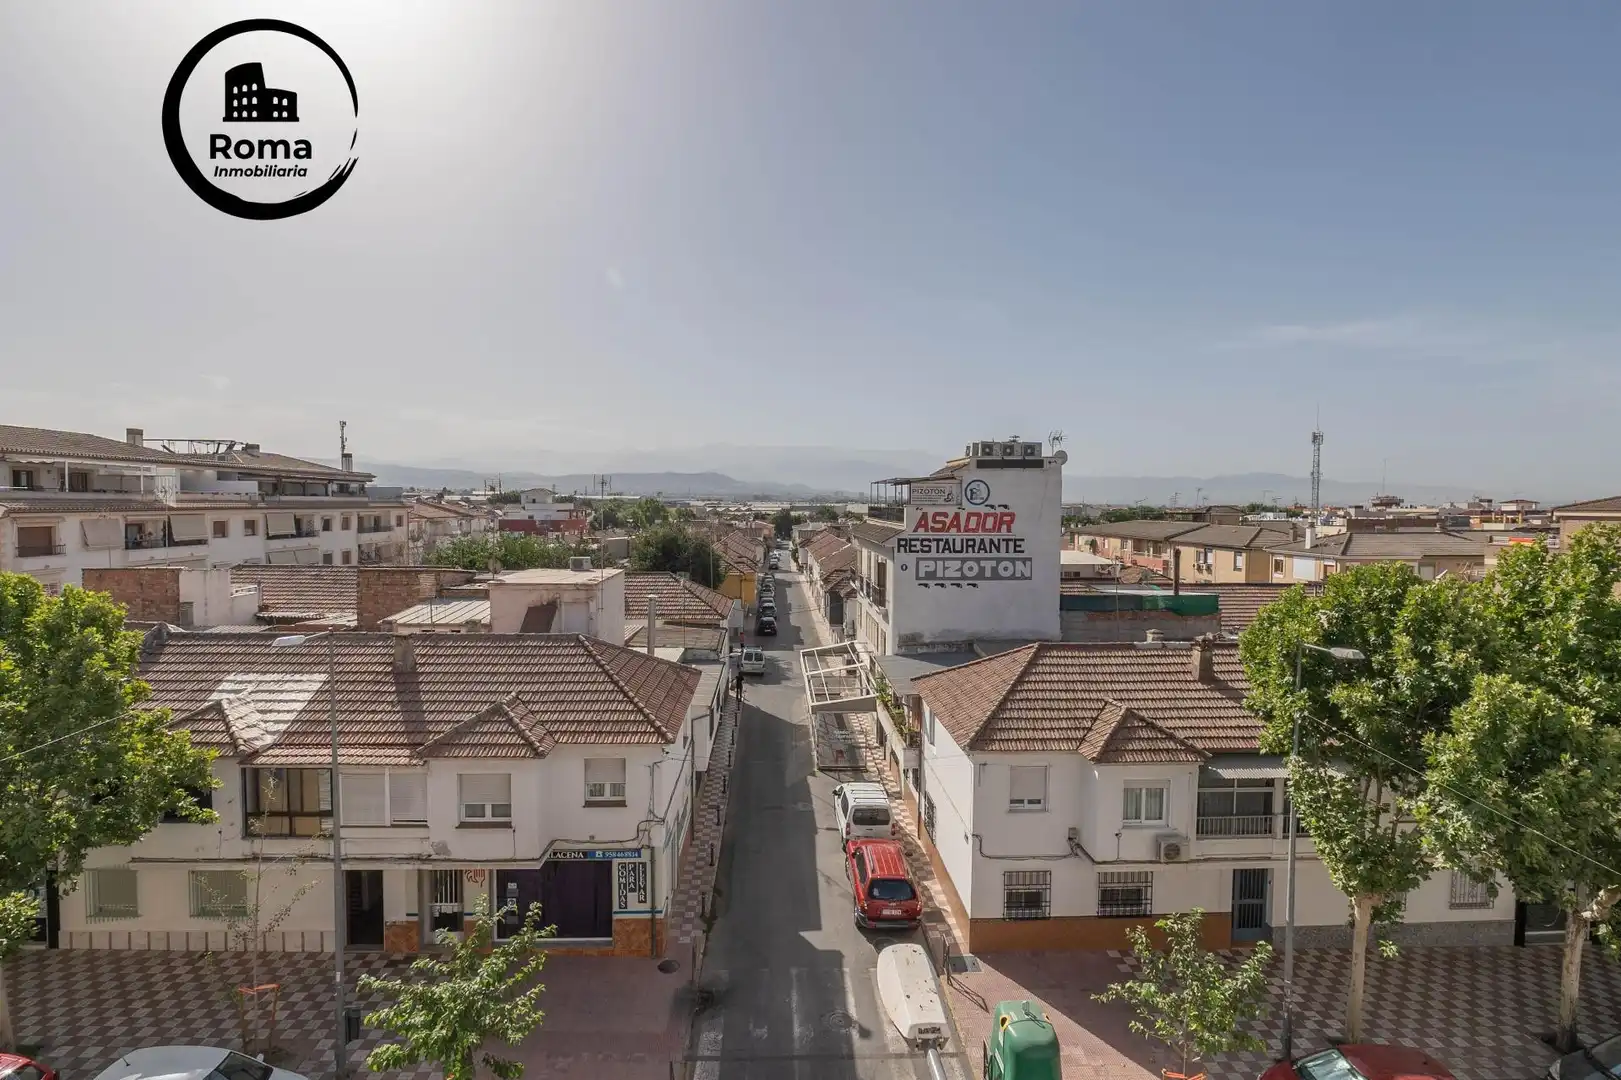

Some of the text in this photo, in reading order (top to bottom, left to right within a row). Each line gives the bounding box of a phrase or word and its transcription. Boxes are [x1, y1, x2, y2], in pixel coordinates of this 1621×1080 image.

[912, 511, 1016, 534] ASADOR
[896, 538, 1025, 554] RESTAURANTE
[918, 560, 1032, 578] PIZOTON
[618, 863, 627, 909] COMIDAS
[628, 863, 636, 889] PARA
